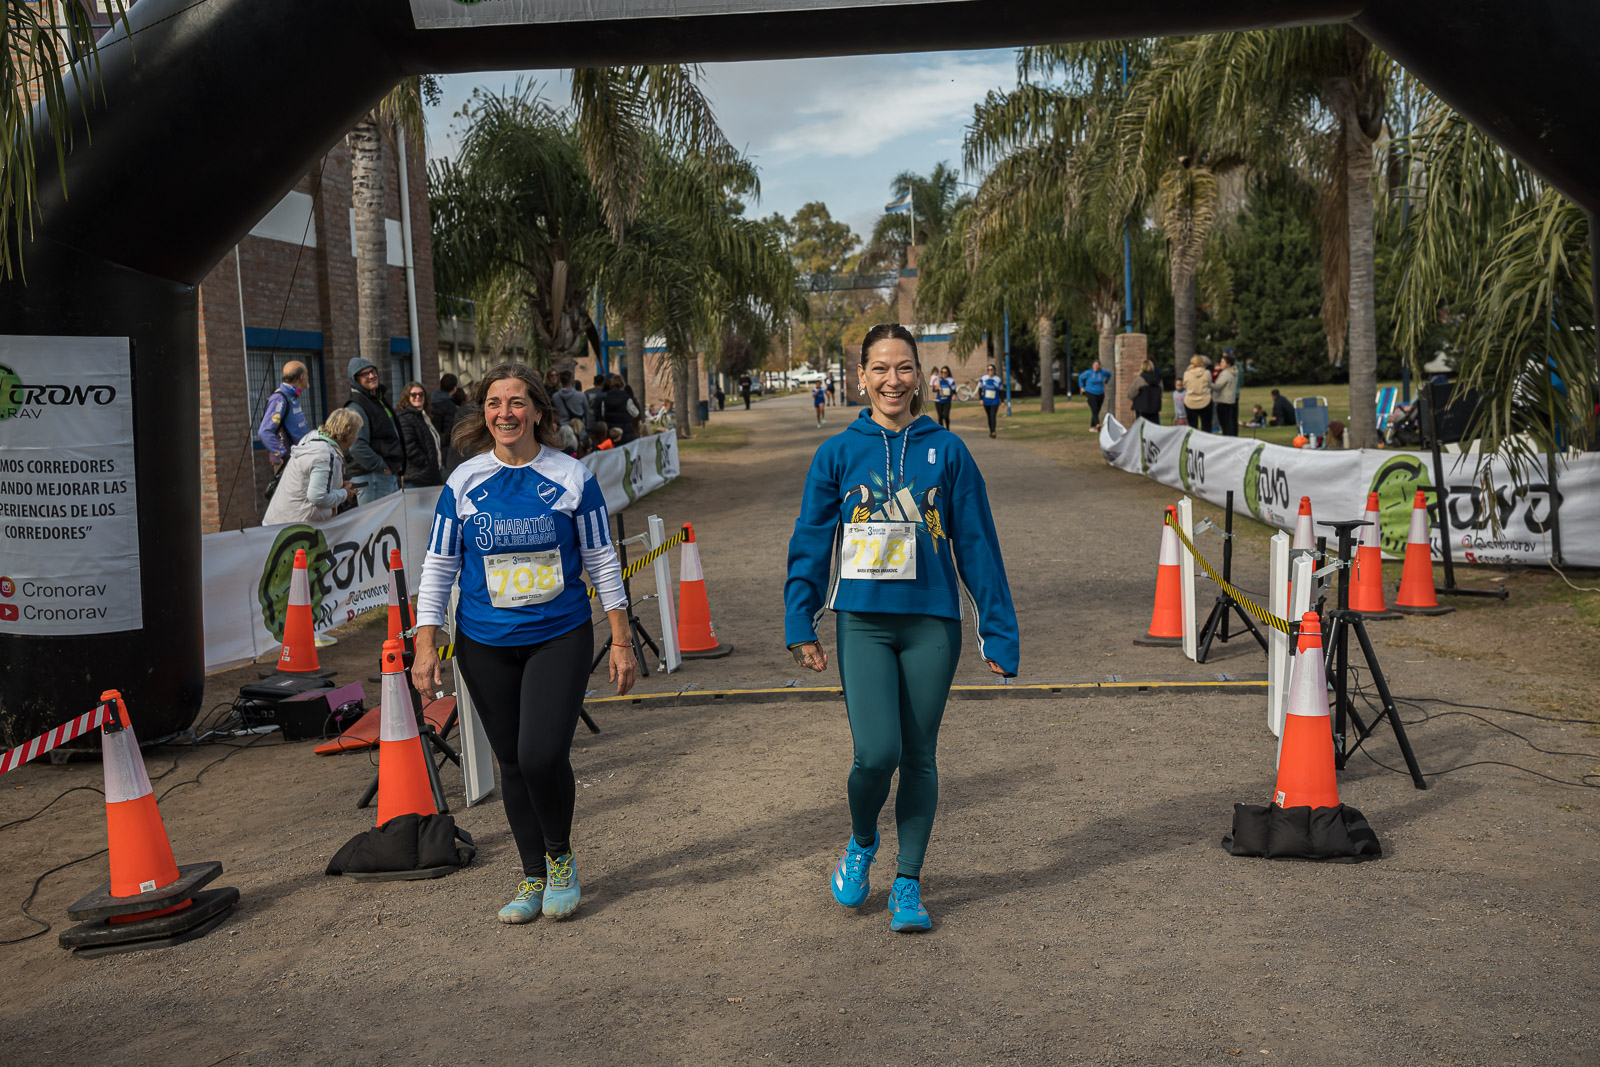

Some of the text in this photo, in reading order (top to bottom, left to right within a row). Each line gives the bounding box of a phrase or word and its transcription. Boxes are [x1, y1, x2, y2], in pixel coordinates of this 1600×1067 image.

[9, 384, 116, 406] CRONO
[8, 408, 42, 419] RAV
[27, 459, 115, 474] CORREDORES
[36, 481, 100, 496] MEJORAR
[103, 480, 127, 495] LAS
[70, 504, 88, 518] DE
[92, 502, 116, 517] LOS
[473, 512, 494, 551] 3
[494, 514, 556, 536] MARATÓN
[851, 539, 906, 566] 718
[492, 564, 556, 597] 708
[22, 581, 107, 598] Cronorav
[23, 605, 108, 621] Cronorav
